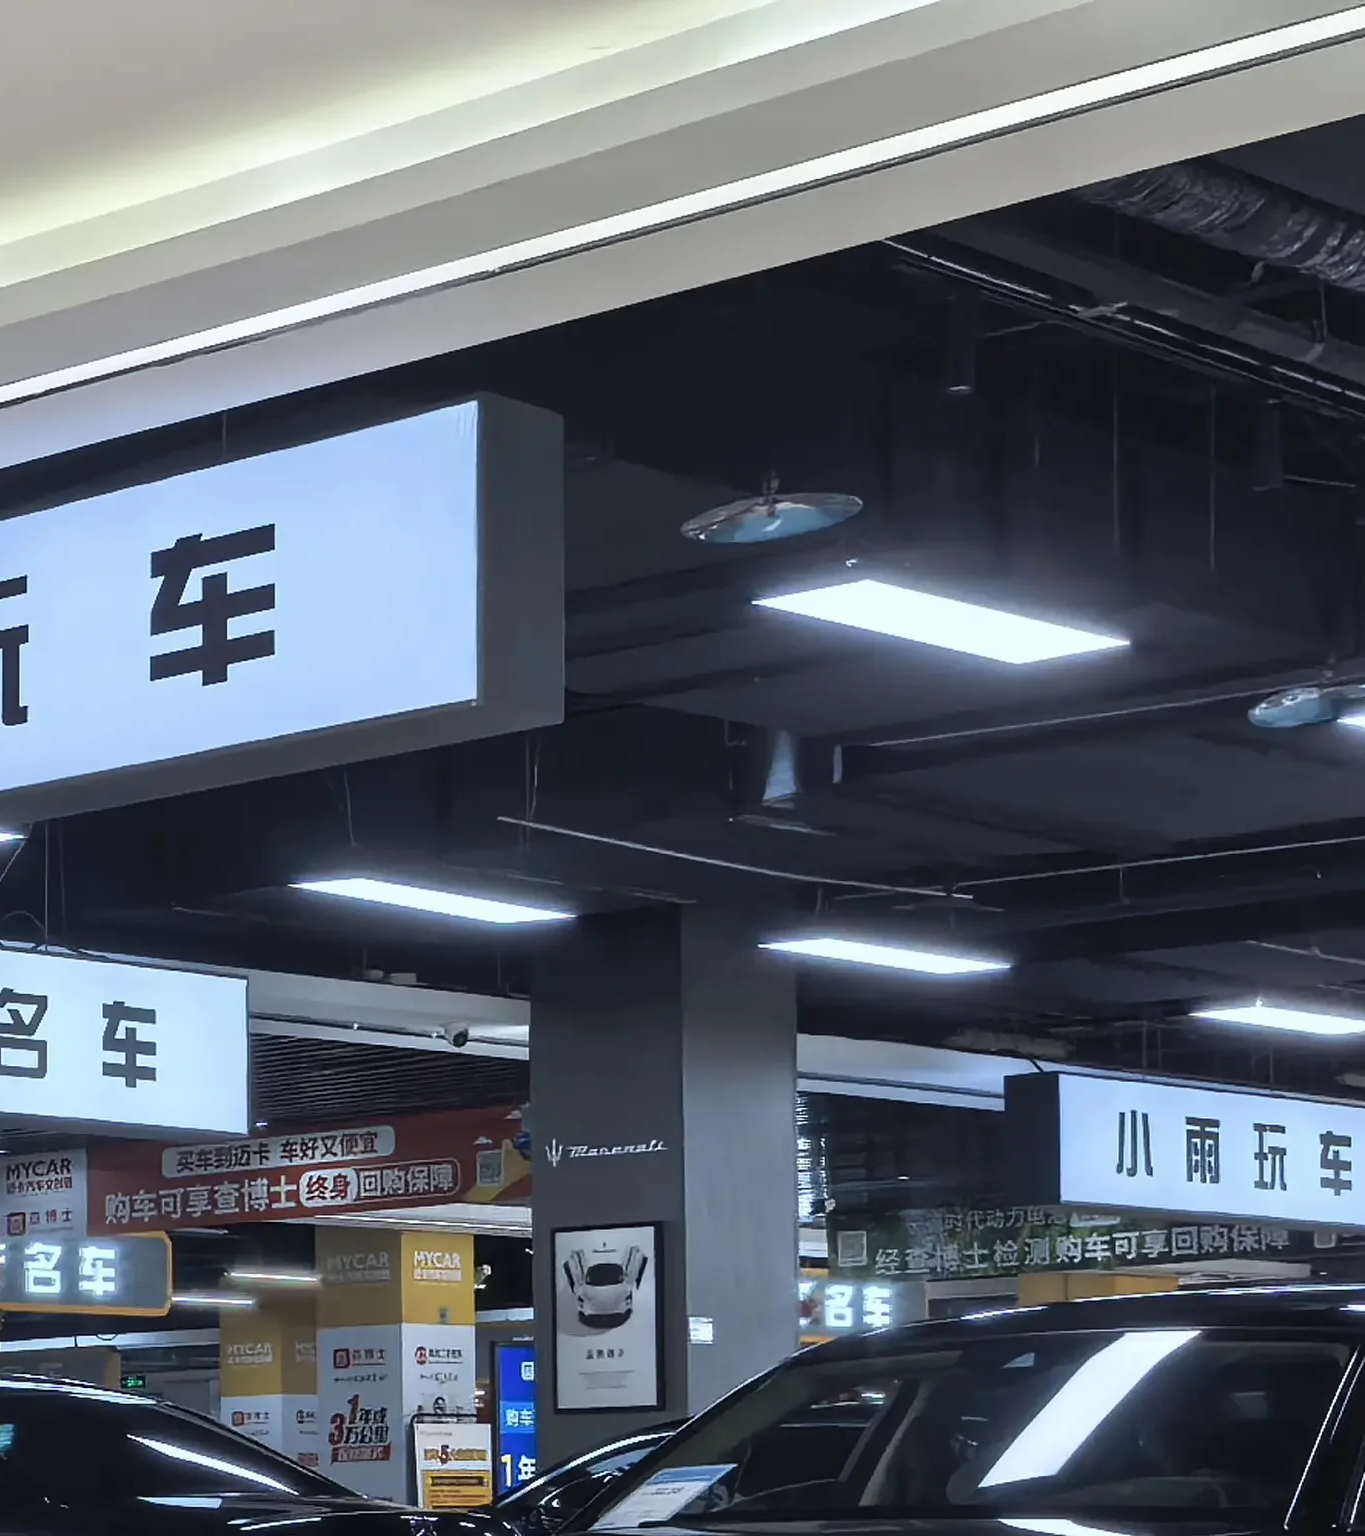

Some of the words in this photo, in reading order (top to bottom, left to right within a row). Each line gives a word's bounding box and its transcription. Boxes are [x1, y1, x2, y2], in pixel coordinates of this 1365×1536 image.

[176, 1142, 270, 1173] 买车到迈卡
[280, 1132, 378, 1160] 车好又便宜
[1116, 1110, 1352, 1196] 小雨玩车
[6, 1158, 72, 1181] MYCAR
[414, 1250, 461, 1268] MYCAR
